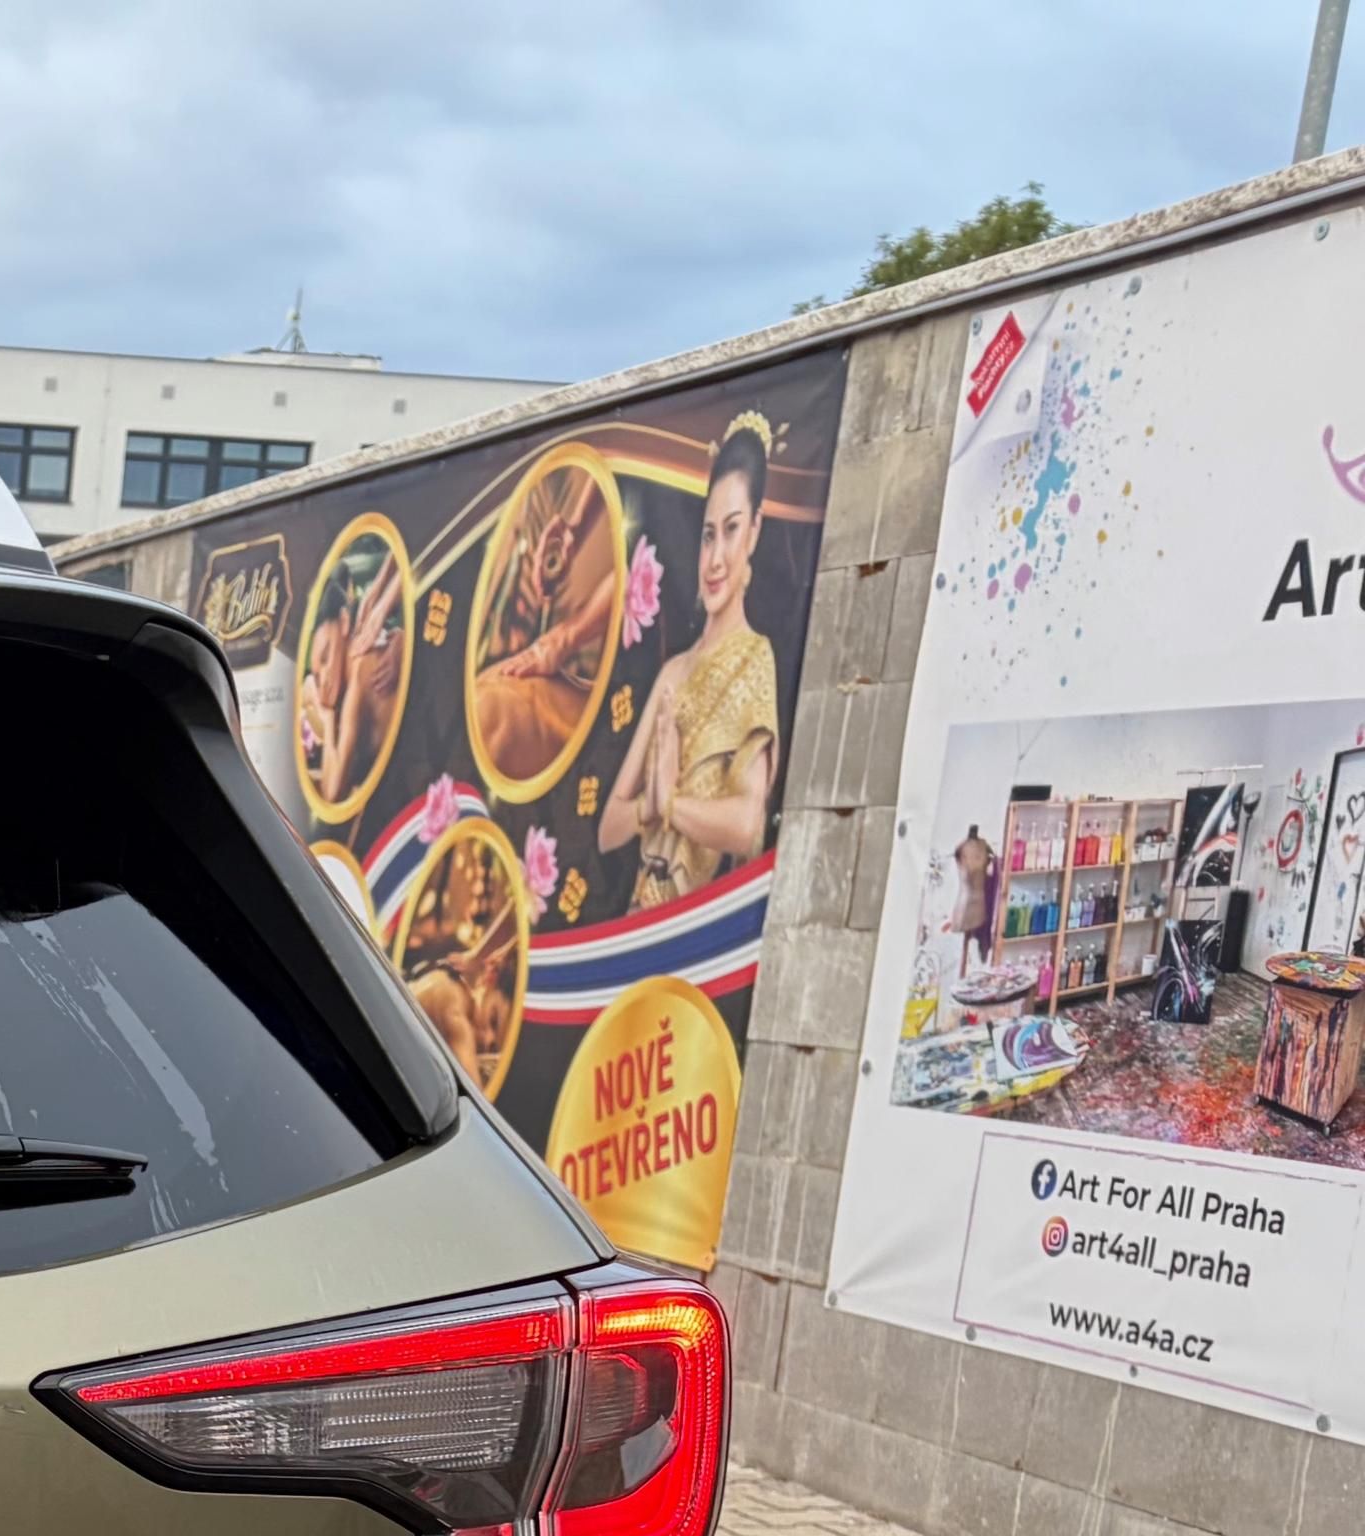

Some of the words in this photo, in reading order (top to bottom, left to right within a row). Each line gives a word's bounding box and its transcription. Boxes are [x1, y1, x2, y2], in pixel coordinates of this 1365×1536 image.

[594, 1016, 674, 1122] NOVĚ
[560, 1092, 718, 1201] OTEVŘENO
[1058, 1170, 1100, 1203] Art
[1107, 1176, 1151, 1211] For
[1156, 1185, 1195, 1219] All
[1201, 1197, 1286, 1235] Praha
[1071, 1230, 1252, 1288] art4all_praha
[1049, 1302, 1214, 1362] www.a4a.cz
